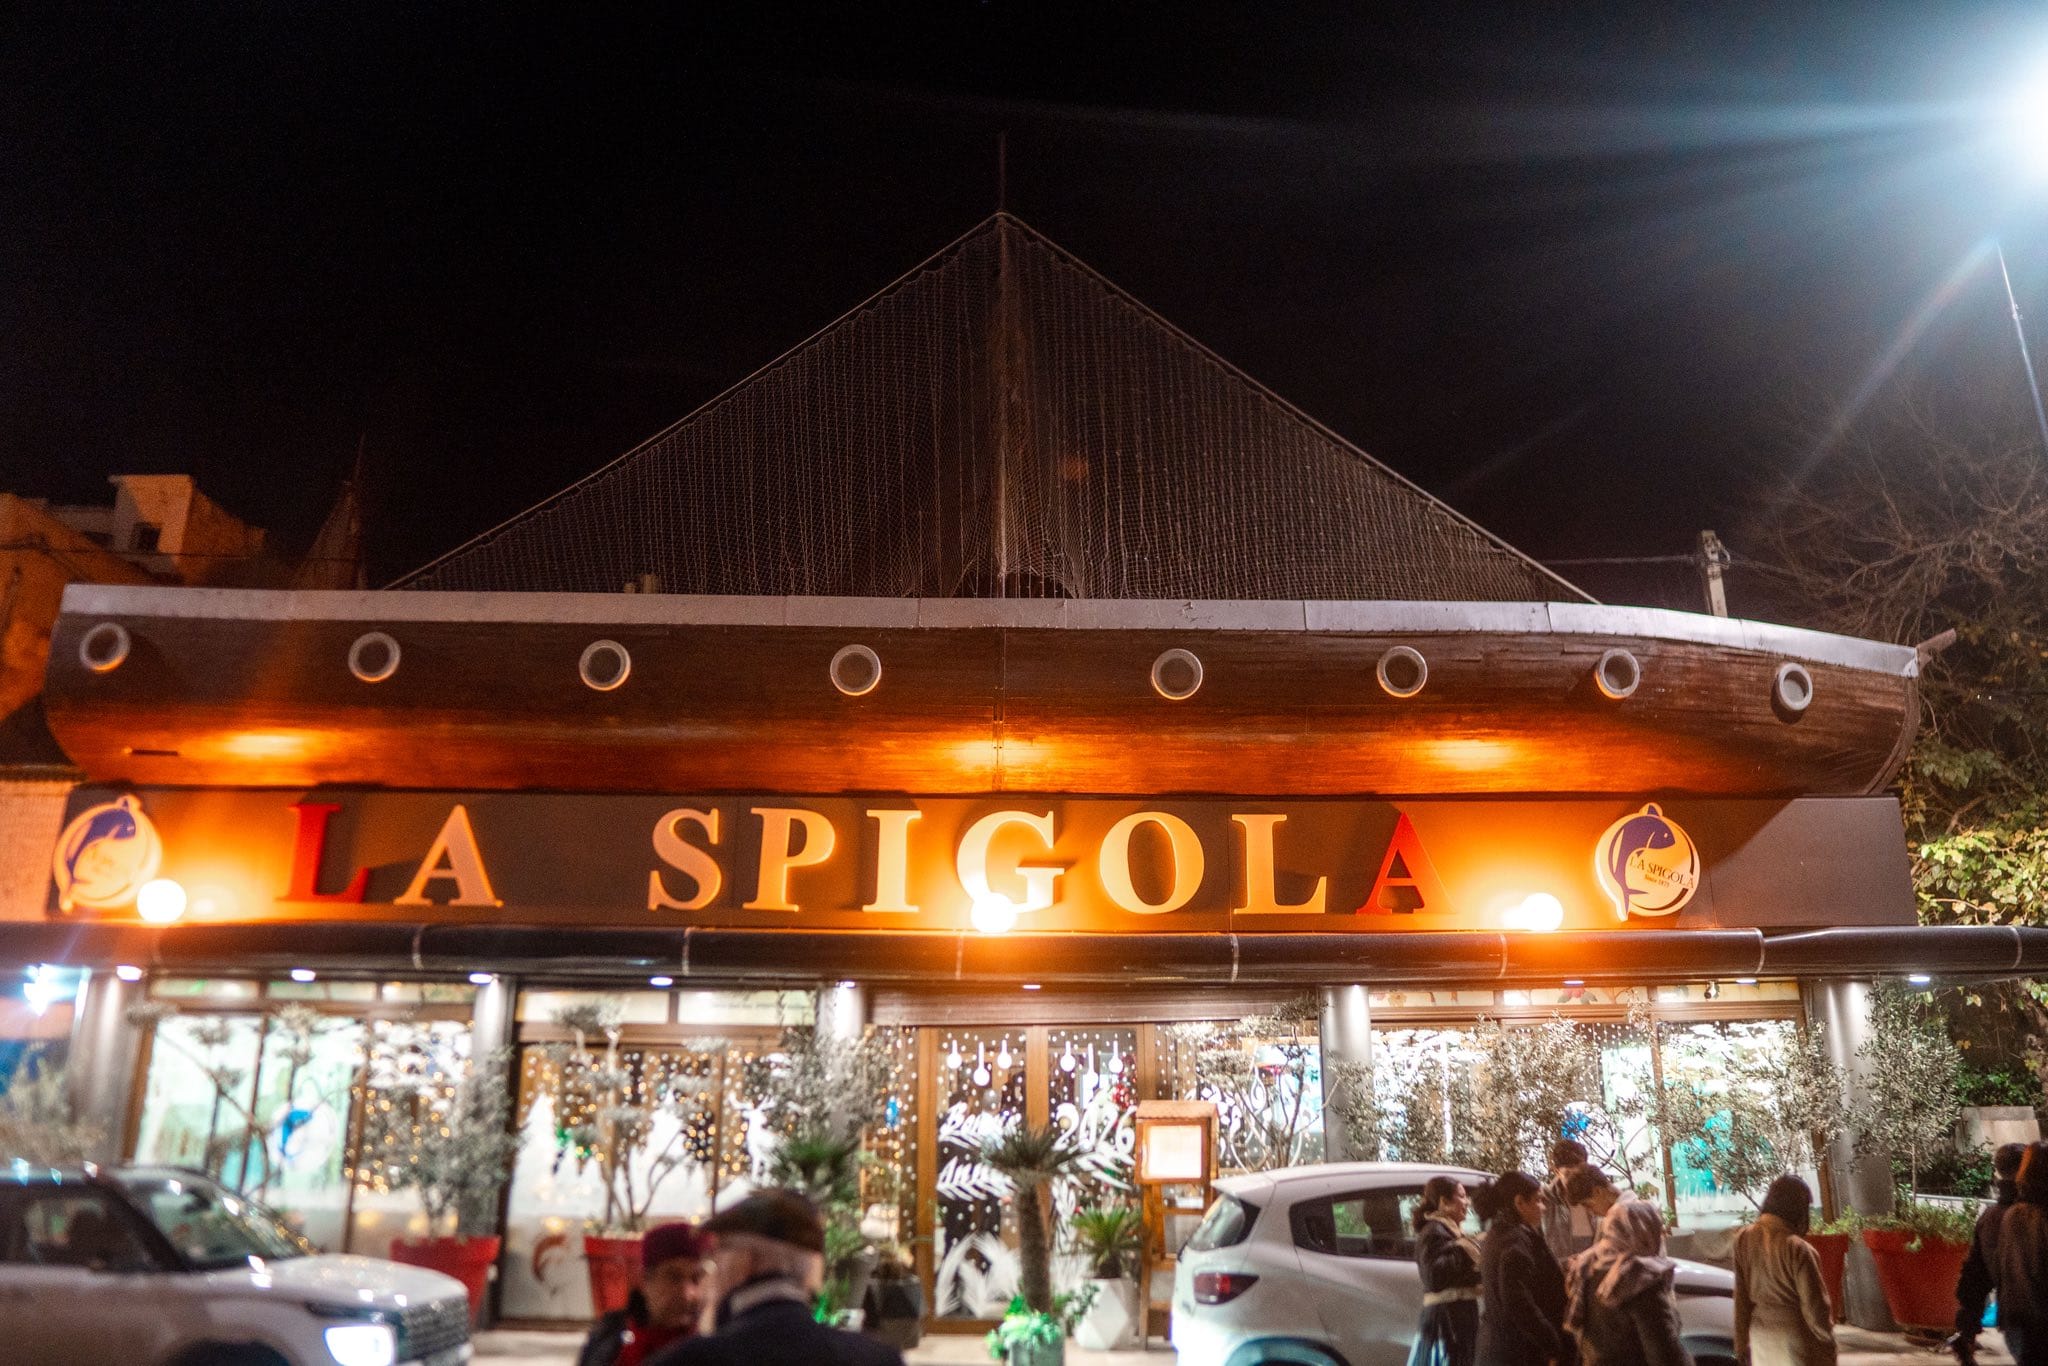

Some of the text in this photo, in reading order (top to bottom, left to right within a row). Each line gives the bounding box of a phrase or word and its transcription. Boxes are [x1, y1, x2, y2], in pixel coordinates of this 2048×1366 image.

[274, 804, 1457, 915] LA SPIGOLA
[1629, 856, 1694, 889] LA SPIGOLA
[1051, 1101, 1138, 1157] 2026
